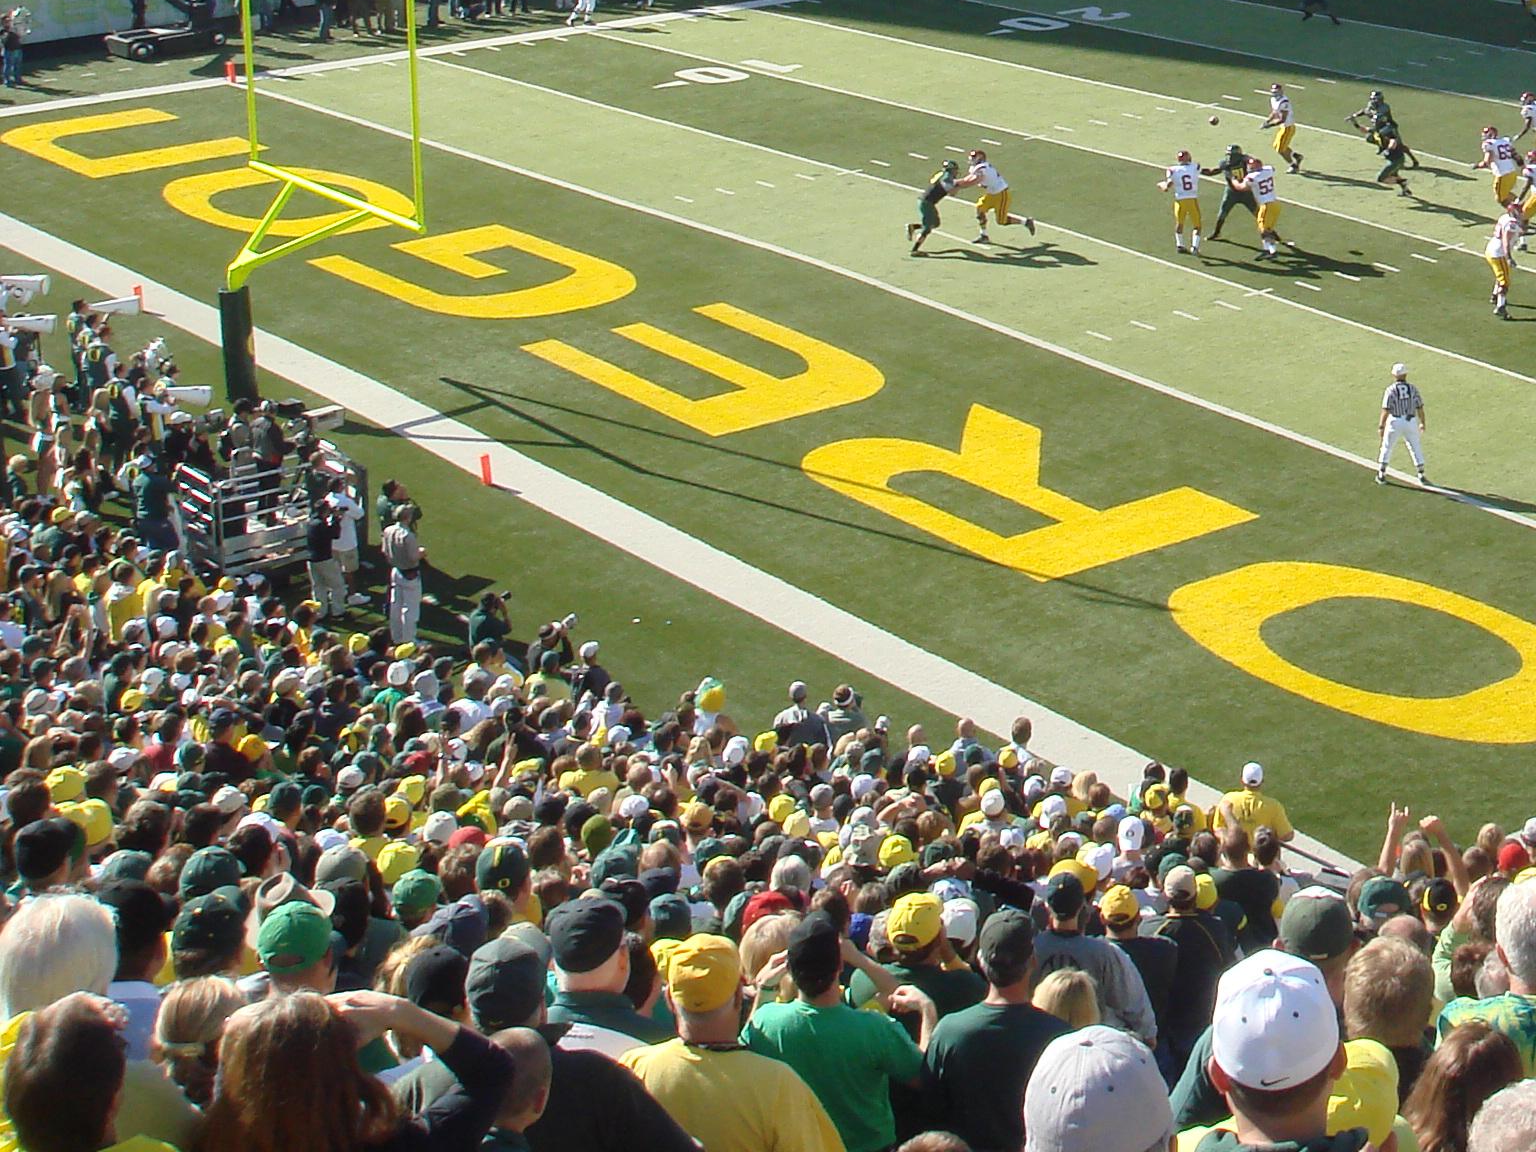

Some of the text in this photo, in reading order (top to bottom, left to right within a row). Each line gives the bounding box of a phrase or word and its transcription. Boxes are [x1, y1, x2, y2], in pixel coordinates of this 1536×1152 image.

[998, 5, 1132, 34] 20
[672, 58, 804, 86] 10
[1180, 174, 1193, 191] 6
[1258, 176, 1275, 196] 53
[1396, 384, 1409, 399] R
